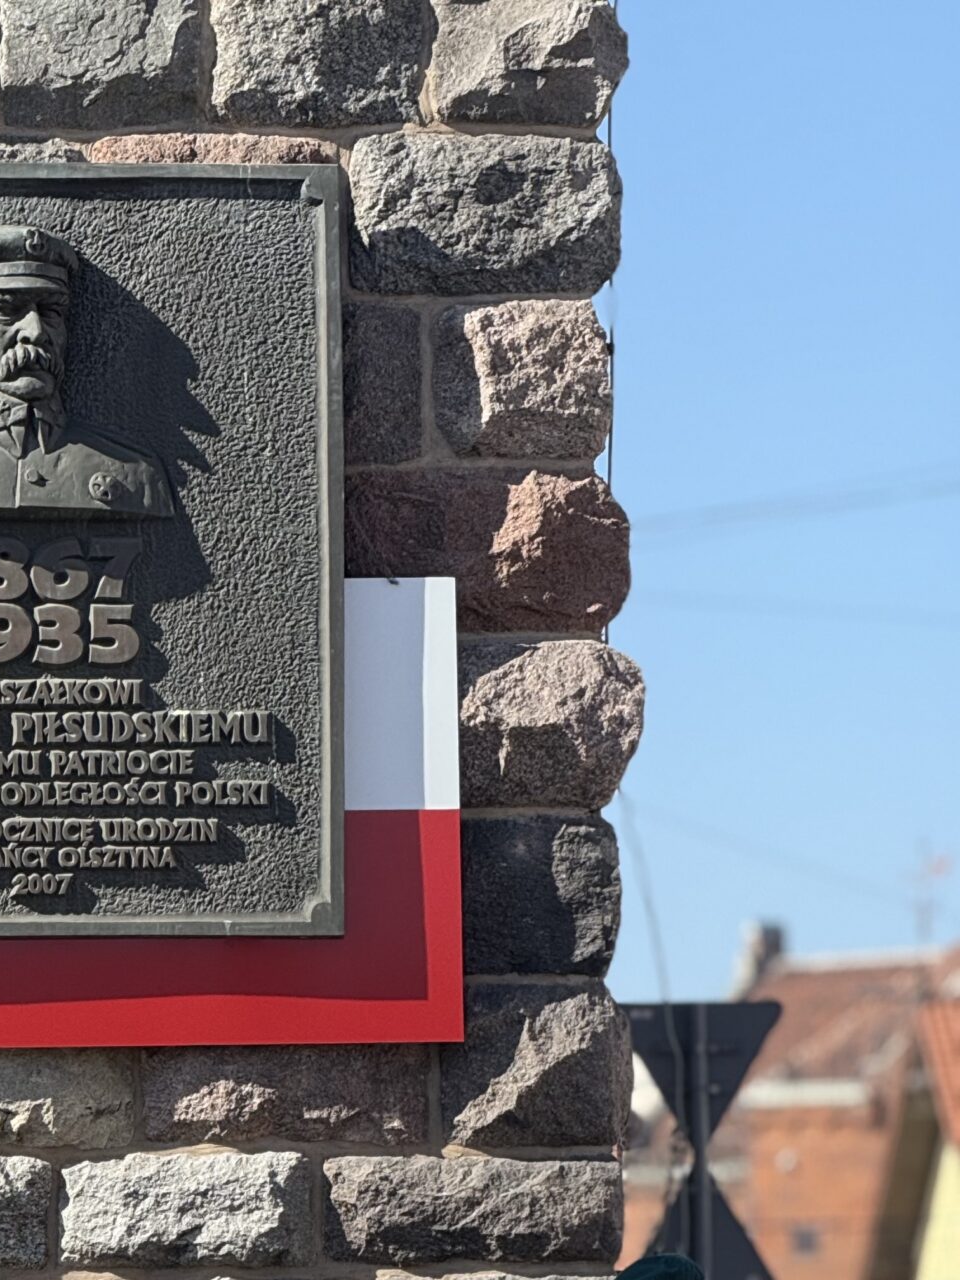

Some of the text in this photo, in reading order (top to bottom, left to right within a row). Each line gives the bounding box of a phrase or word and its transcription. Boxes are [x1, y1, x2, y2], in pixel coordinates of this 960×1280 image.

[11, 710, 270, 746] PIŁSUDSKIEMU
[48, 749, 195, 778] PATRIOCIE
[175, 779, 269, 807] POLSKI
[99, 817, 218, 843] URODZIN
[58, 845, 176, 869] OLSZTYNA
[9, 873, 74, 897] 2007
